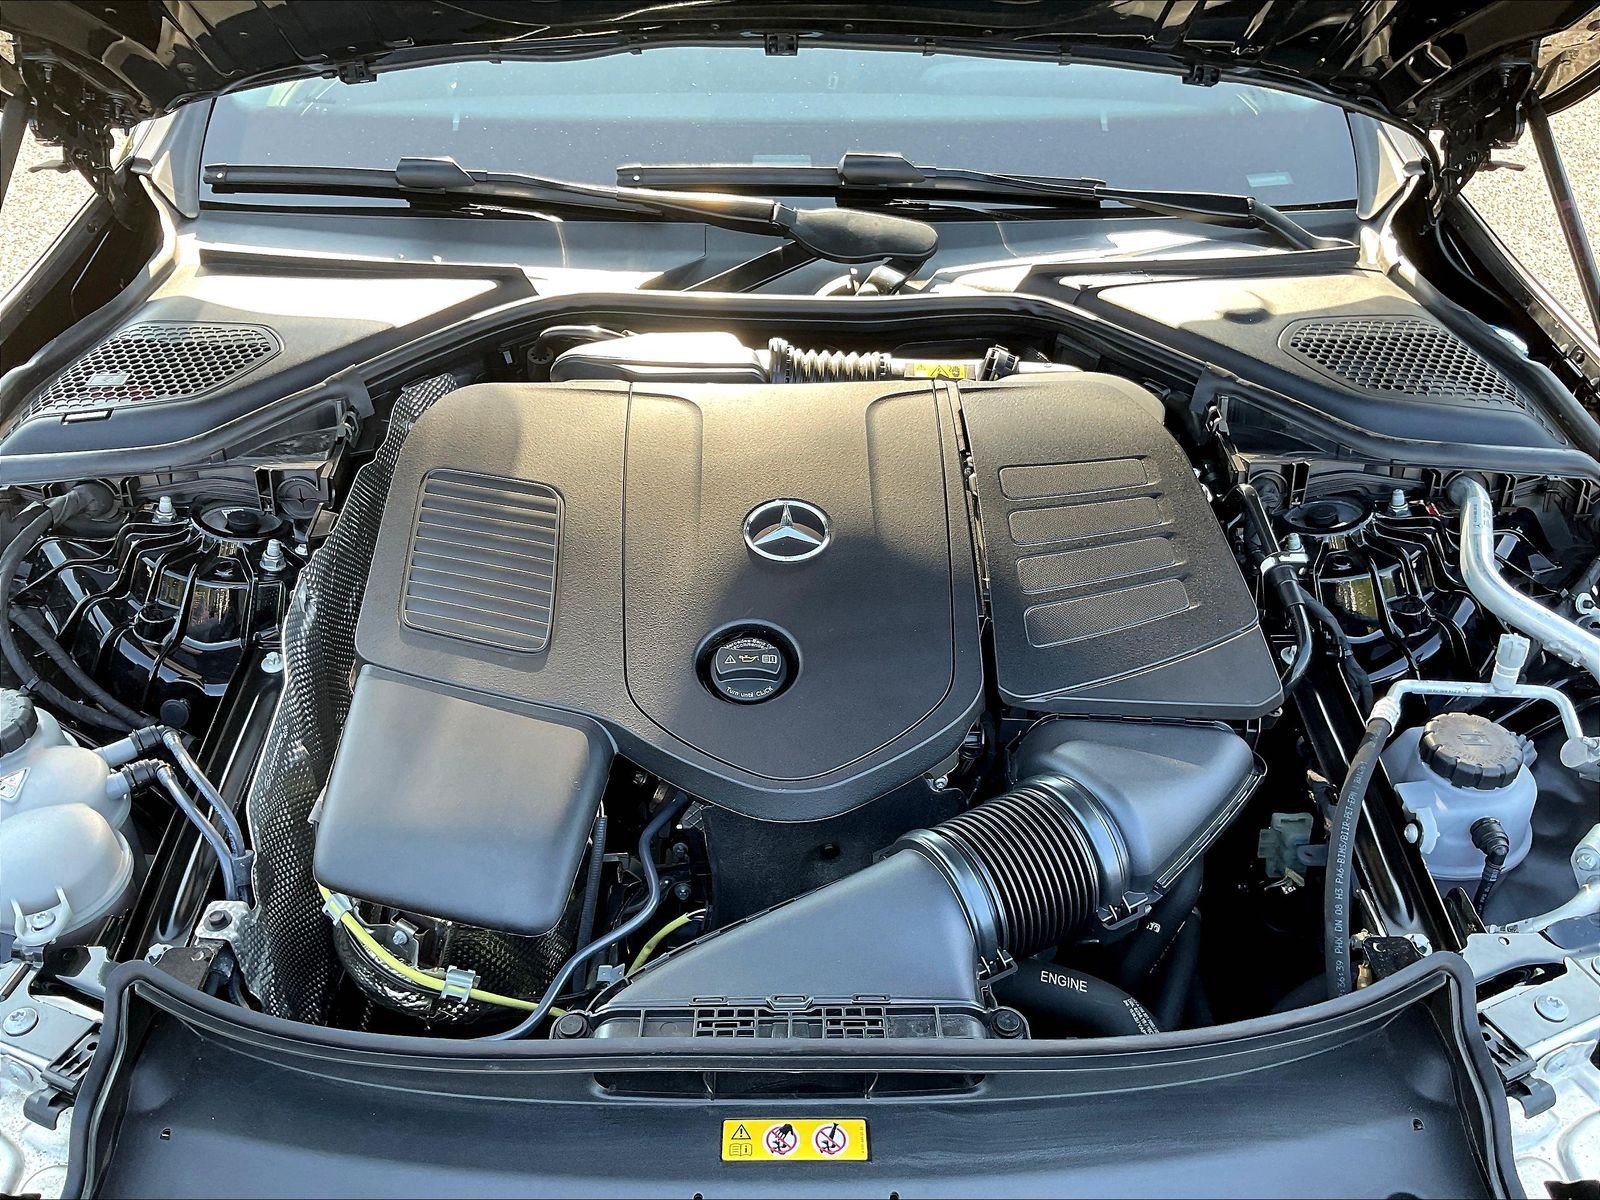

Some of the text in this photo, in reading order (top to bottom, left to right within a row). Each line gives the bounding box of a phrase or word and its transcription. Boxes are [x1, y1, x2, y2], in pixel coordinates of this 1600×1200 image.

[726, 686, 739, 696] Turn
[755, 685, 774, 697] CLICK
[1335, 887, 1344, 900] H3
[1335, 919, 1343, 932] DN
[1334, 936, 1343, 954] PHX
[1040, 970, 1089, 993] ENGINE
